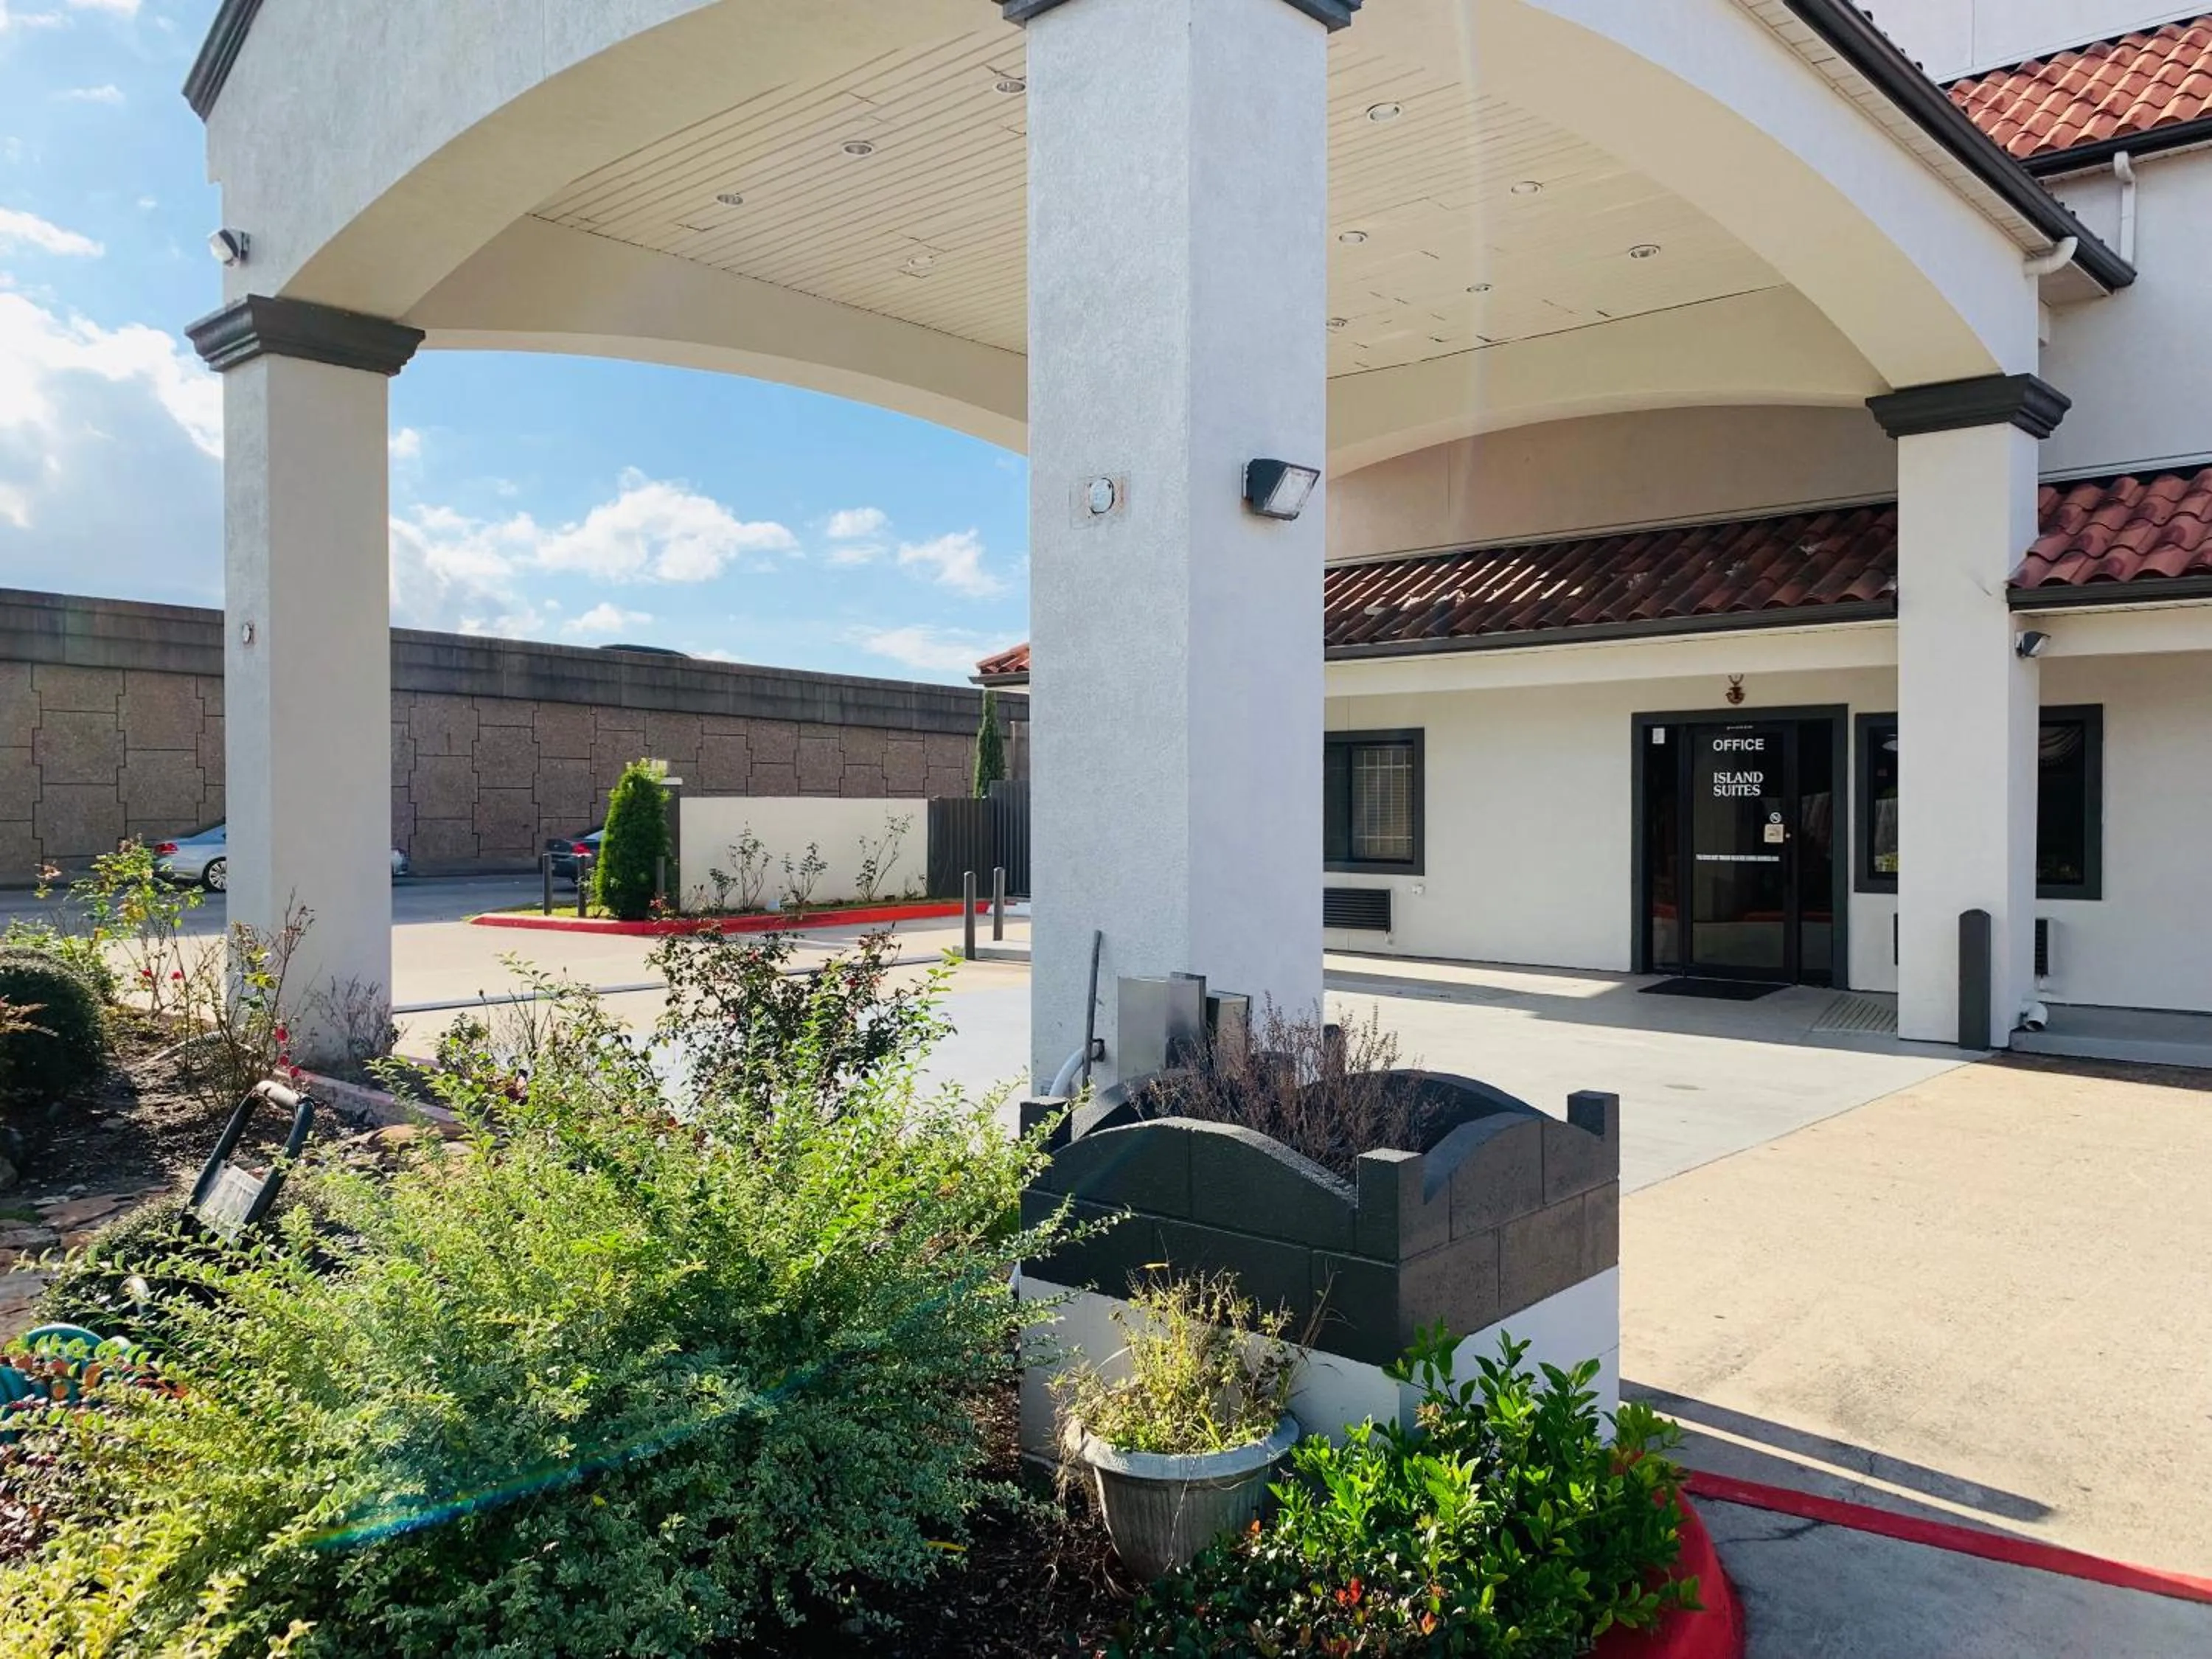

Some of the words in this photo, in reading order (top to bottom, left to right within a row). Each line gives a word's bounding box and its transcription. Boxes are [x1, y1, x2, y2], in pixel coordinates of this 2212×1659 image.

[1713, 738, 1764, 751] OFFICE
[1713, 771, 1764, 784] ISLAND
[1713, 784, 1761, 796] SUITES
